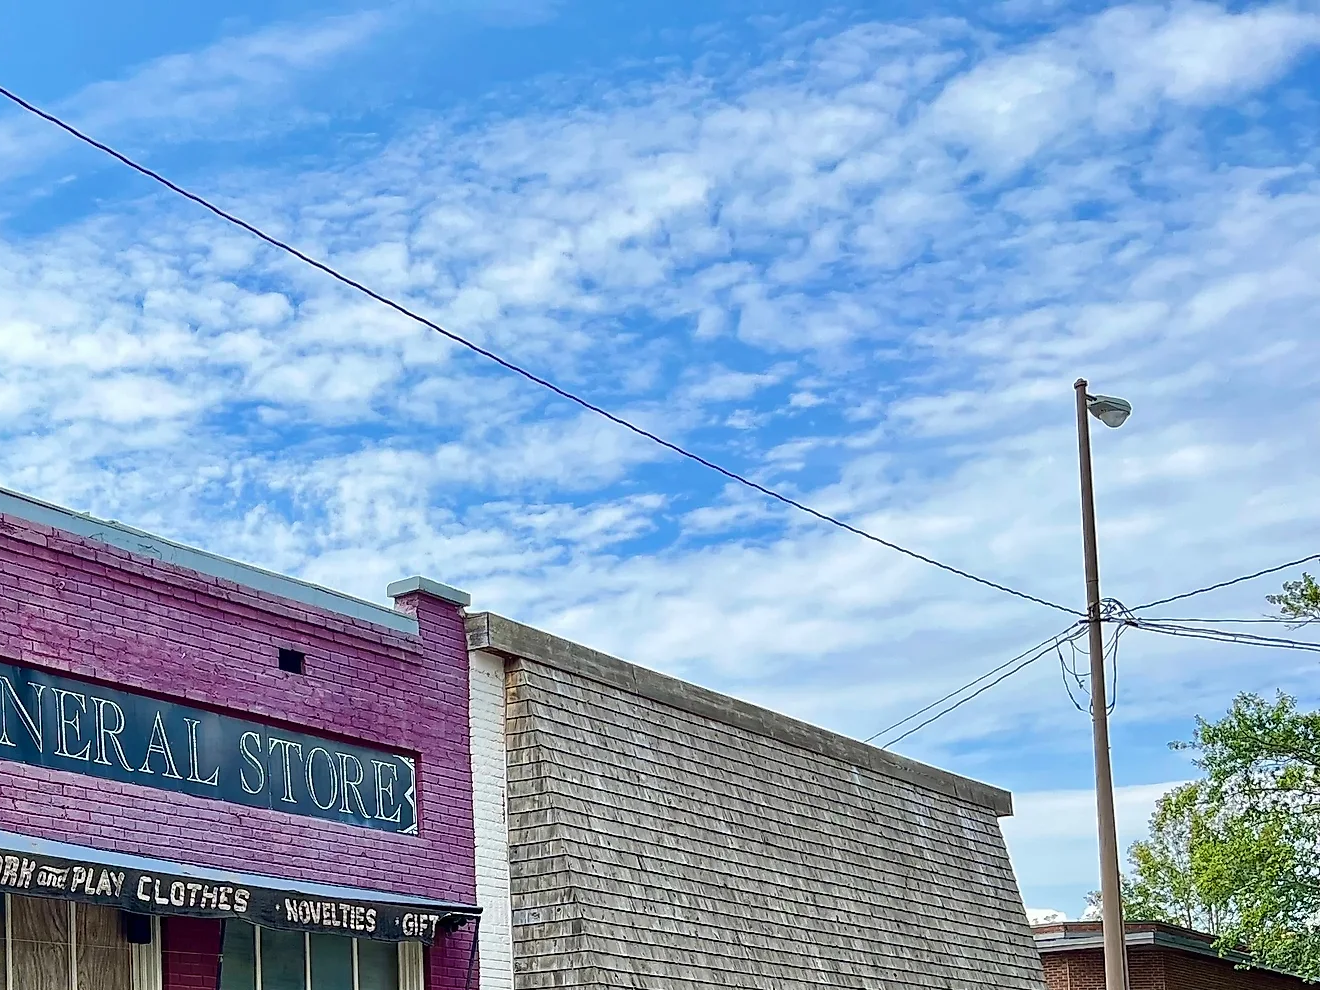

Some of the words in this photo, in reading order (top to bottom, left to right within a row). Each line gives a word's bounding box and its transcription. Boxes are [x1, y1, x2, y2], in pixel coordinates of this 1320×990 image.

[240, 731, 403, 823] STORE
[36, 866, 71, 890] and
[71, 866, 125, 897] PLAY
[136, 875, 251, 913] CLOTHES
[284, 898, 377, 933] NOVELTIES
